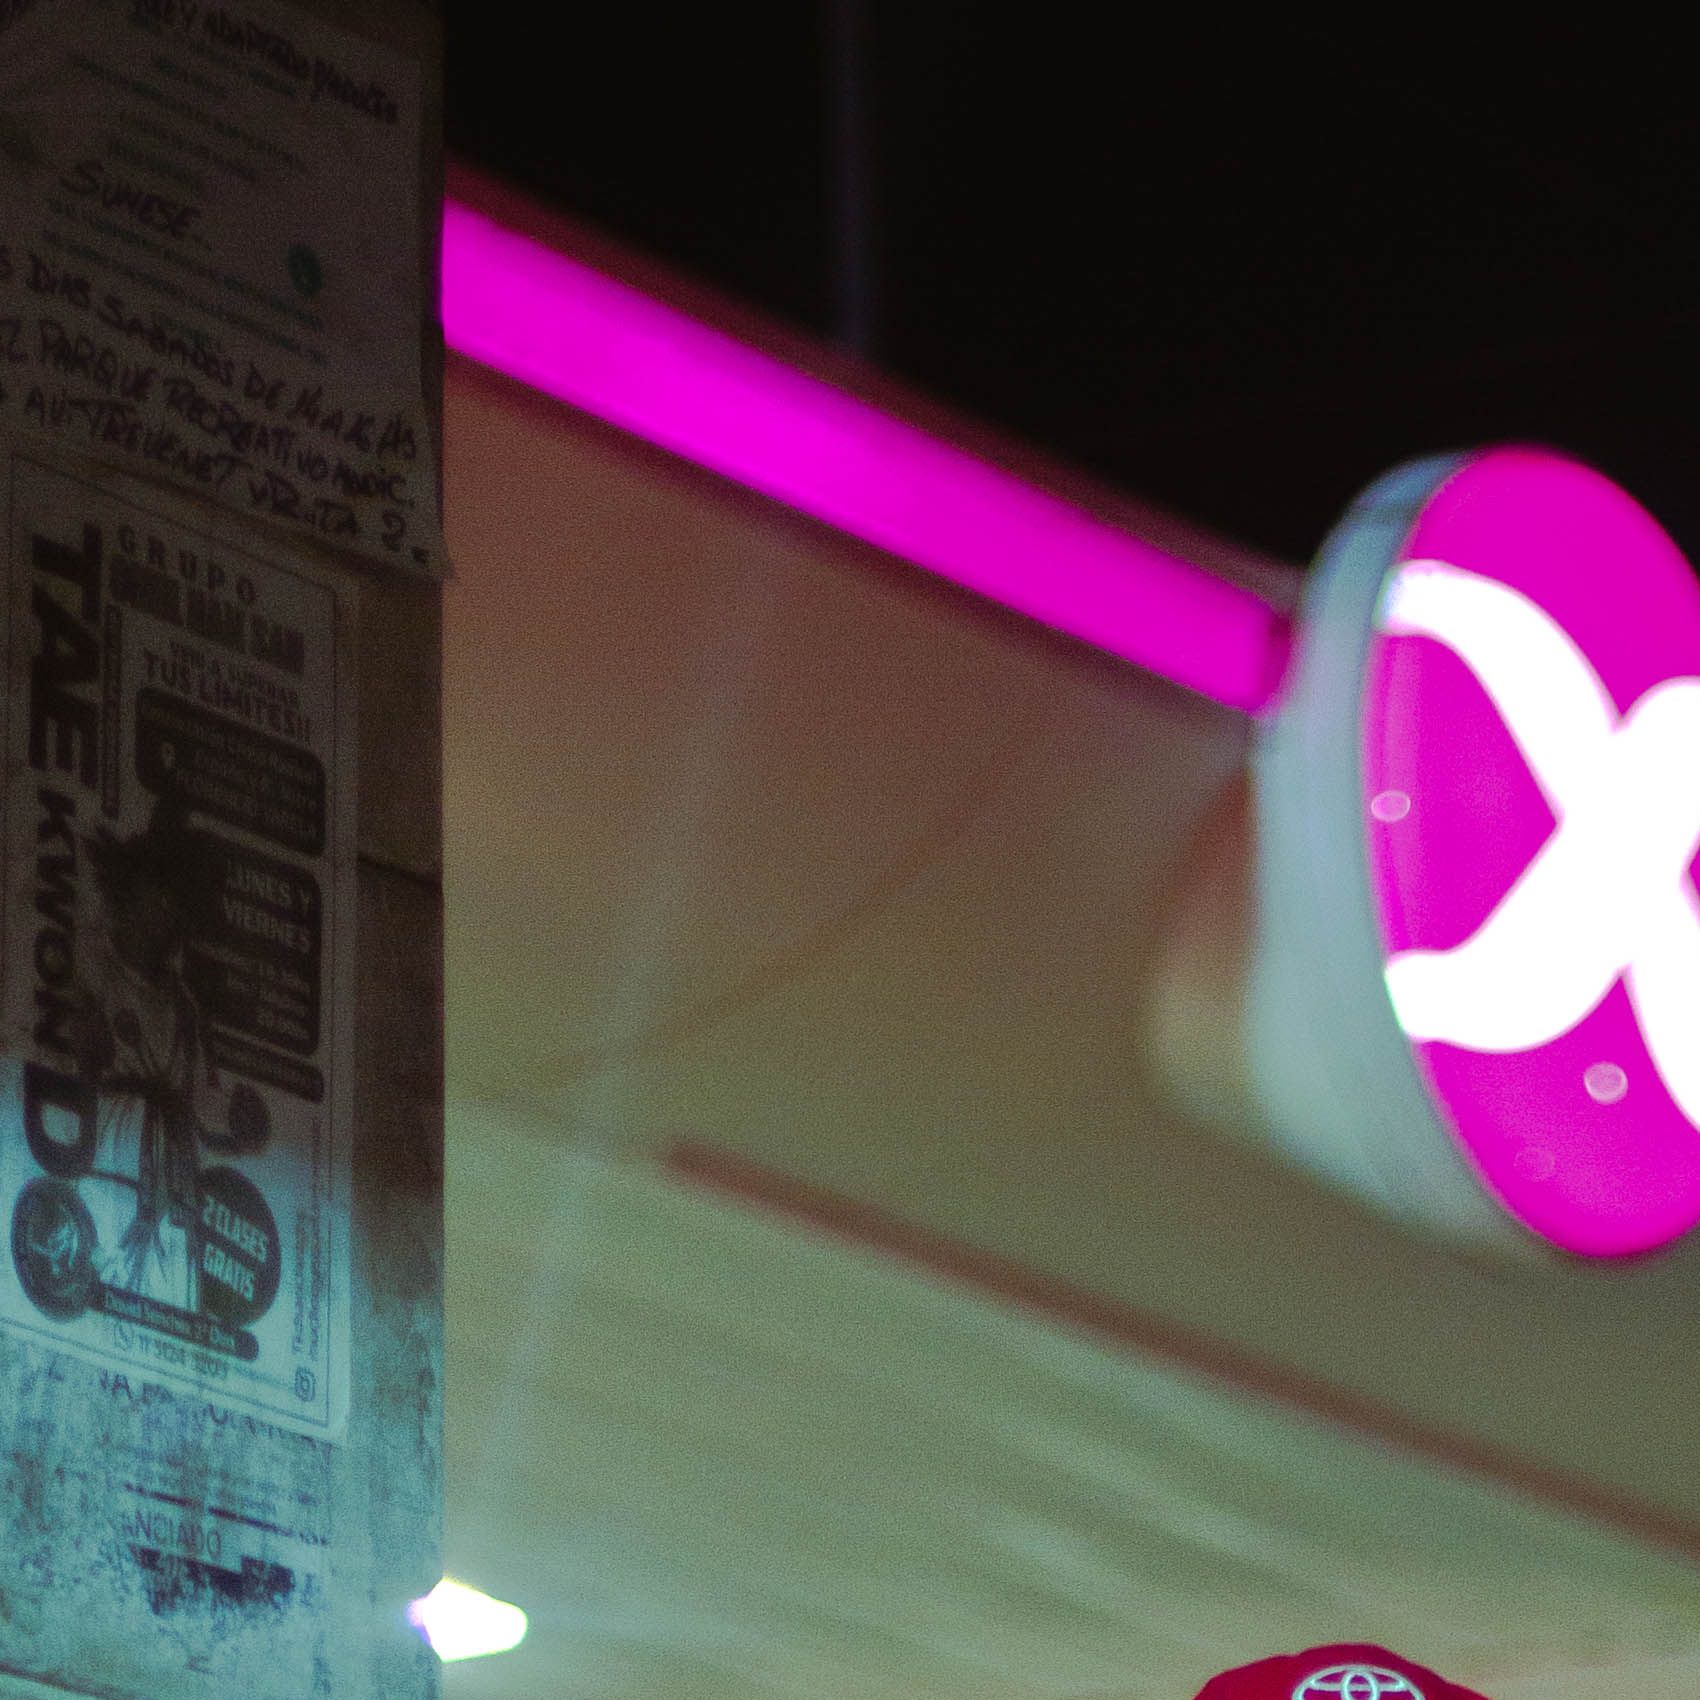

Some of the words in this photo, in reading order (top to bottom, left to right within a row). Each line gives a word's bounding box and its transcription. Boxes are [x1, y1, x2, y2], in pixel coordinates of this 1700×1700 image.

[117, 523, 256, 606] GRUPO
[222, 895, 313, 954] VIERNES
[202, 1242, 257, 1303] GRATIS
